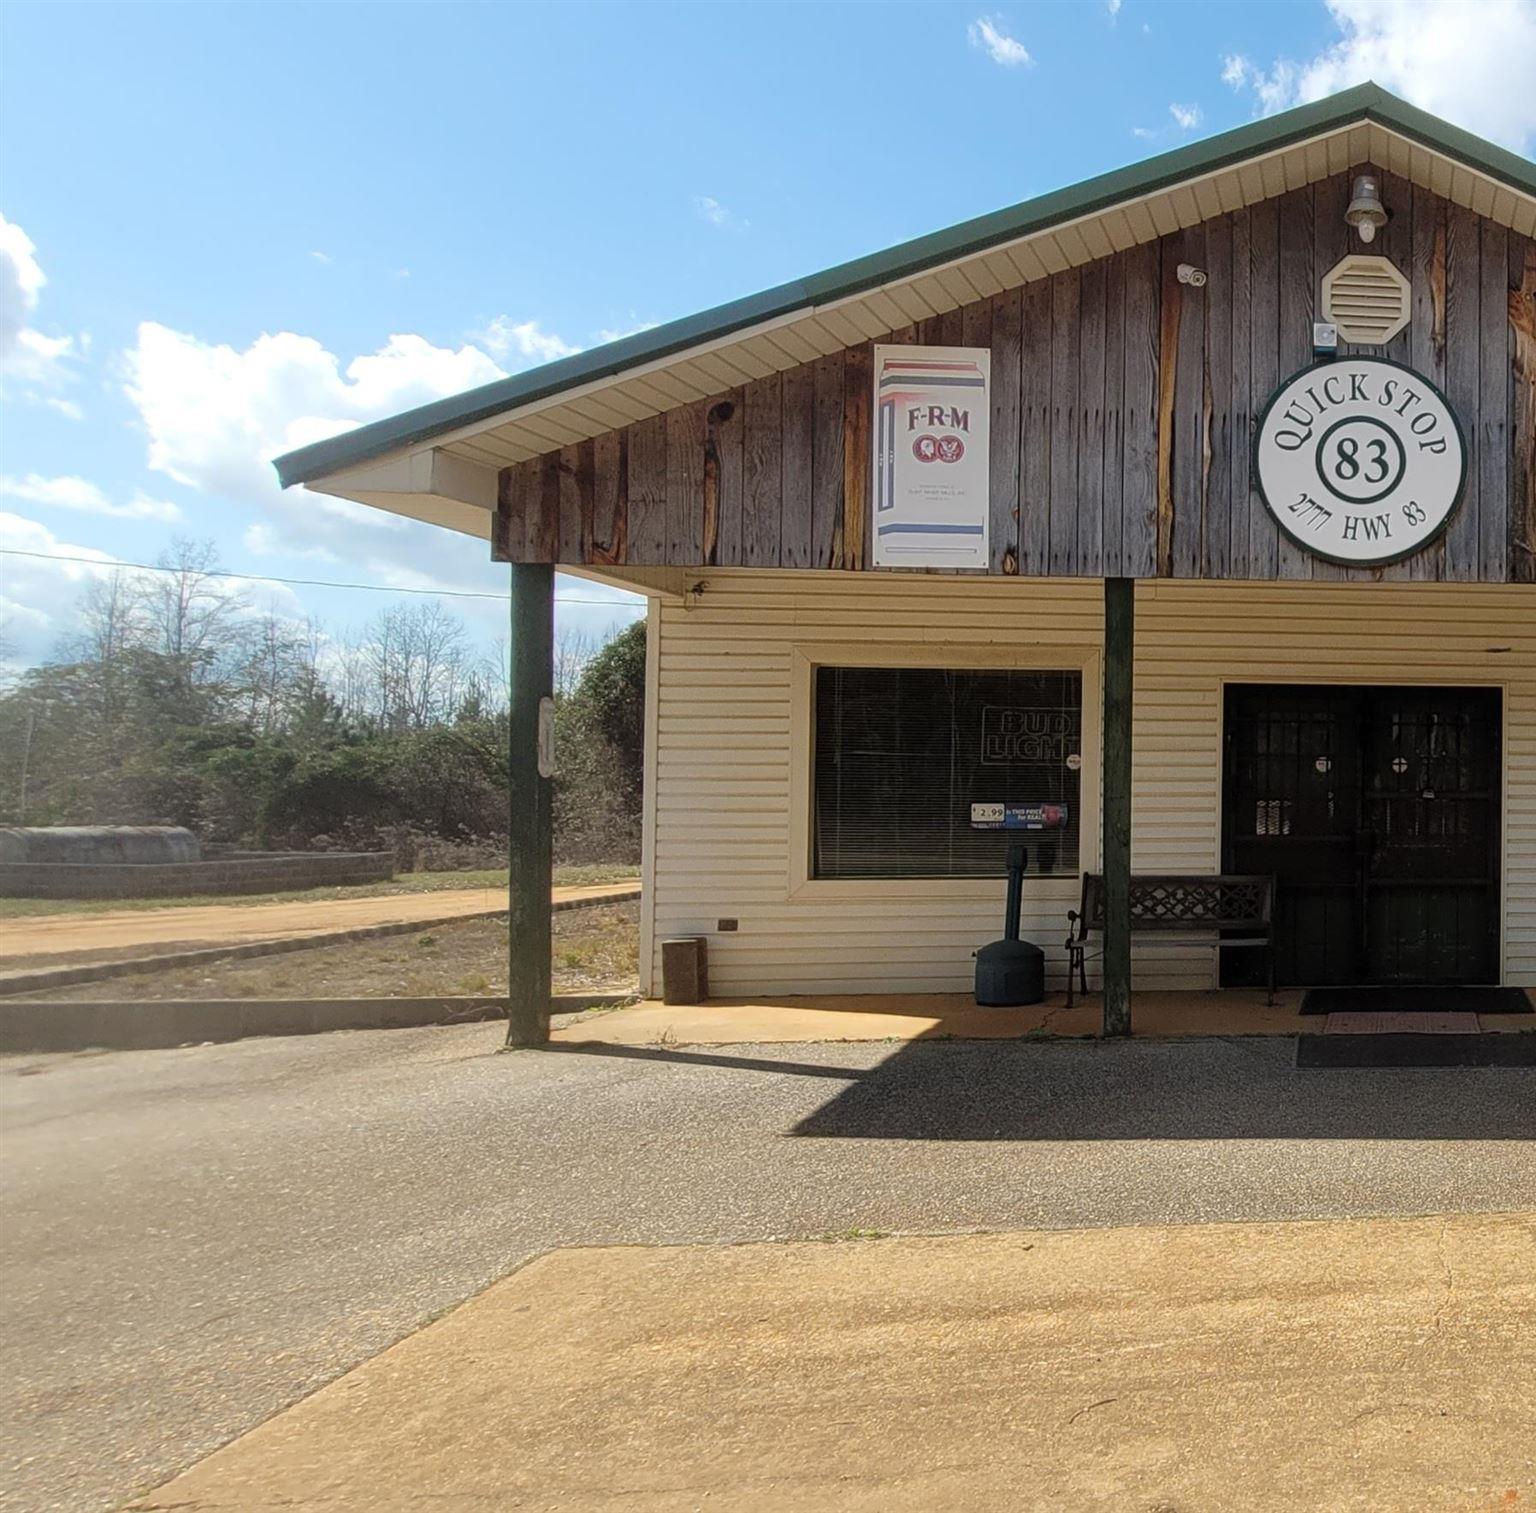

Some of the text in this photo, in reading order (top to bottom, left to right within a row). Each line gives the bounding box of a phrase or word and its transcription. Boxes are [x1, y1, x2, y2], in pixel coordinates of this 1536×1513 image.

[908, 405, 970, 433] F-R-M
[1274, 374, 1447, 454] QUICK STOP
[1335, 437, 1390, 483] 83
[1287, 492, 1427, 541] 2777 HWY 83
[1001, 711, 1072, 735] BUD
[980, 808, 1004, 817] 2.99
